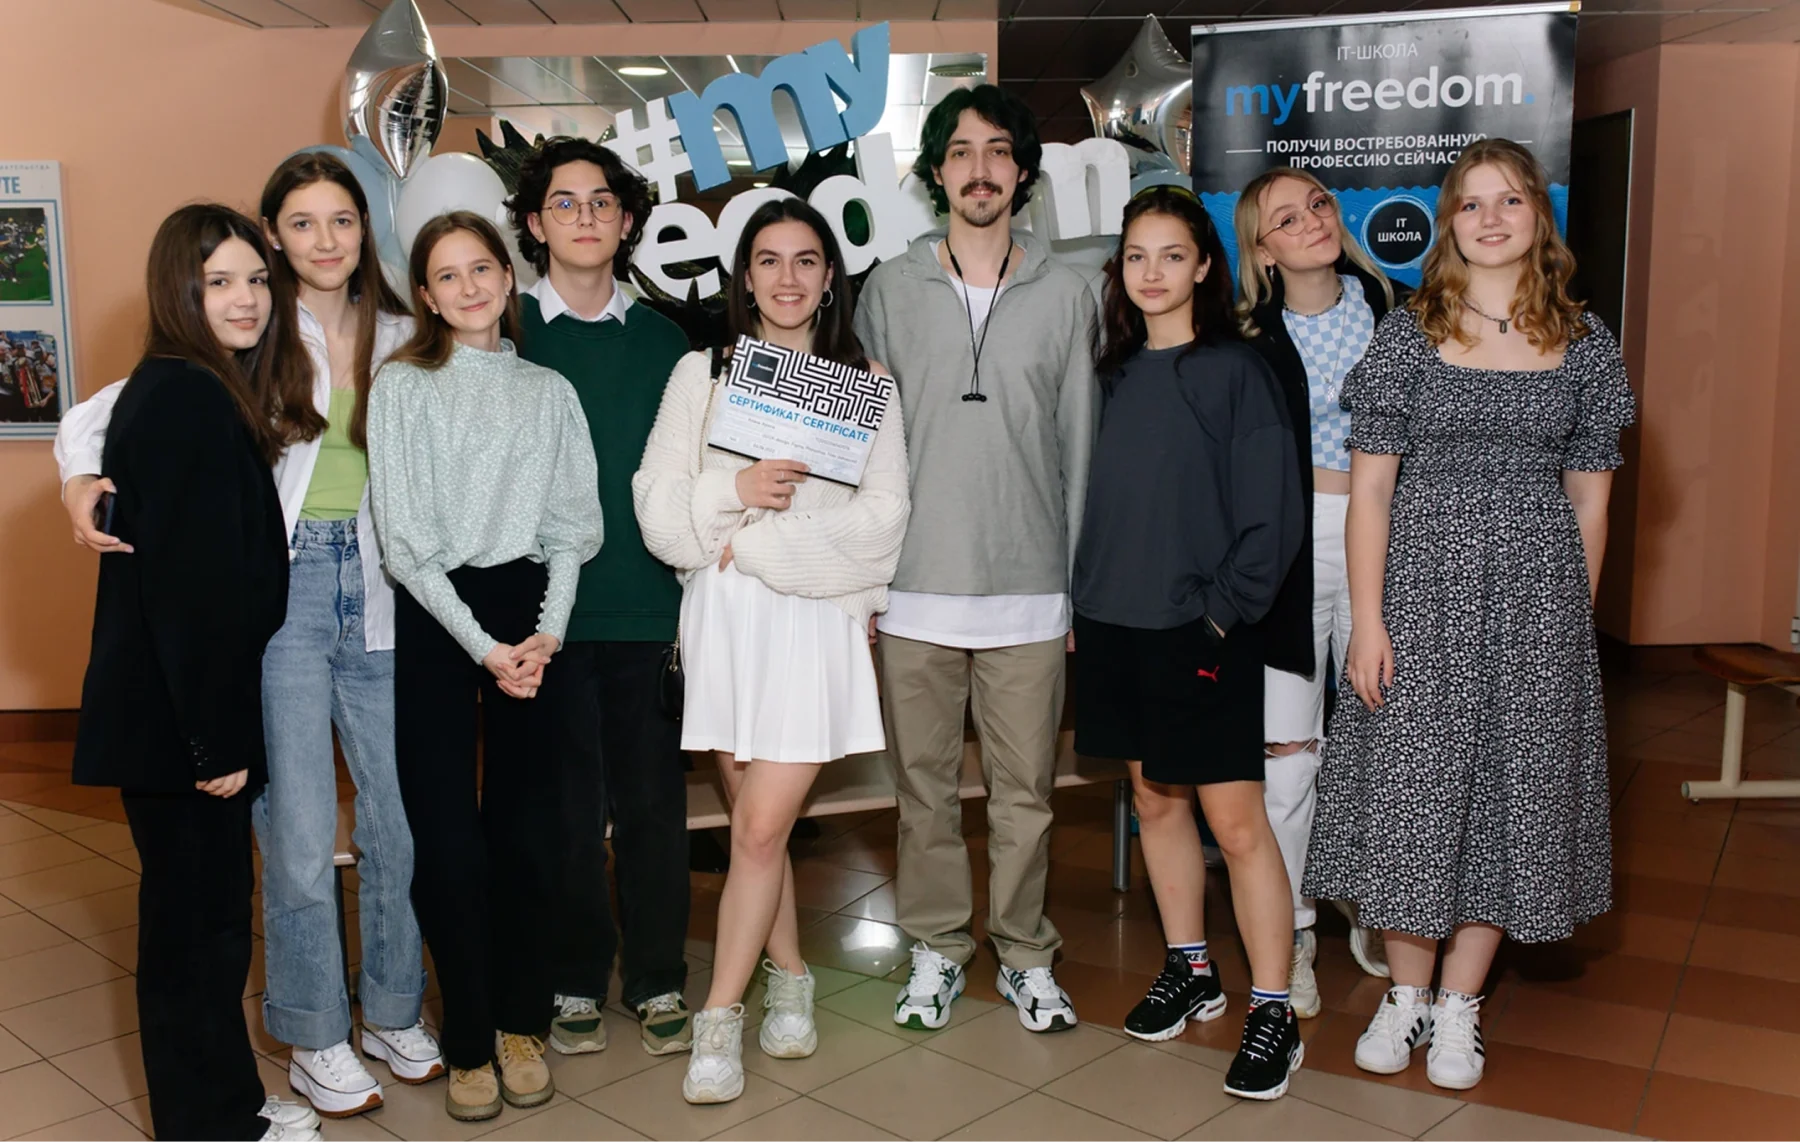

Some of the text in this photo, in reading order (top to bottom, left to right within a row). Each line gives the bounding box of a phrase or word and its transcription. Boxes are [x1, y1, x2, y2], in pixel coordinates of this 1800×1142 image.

[1336, 42, 1419, 62] IT-ШКОЛА
[600, 20, 891, 204] #my
[1266, 138, 1331, 154] ПОЛУЧИ
[1289, 152, 1391, 169] ПРОФЕССИЮ
[1395, 217, 1408, 229] IT
[1377, 230, 1423, 243] ШКОЛА
[728, 393, 801, 423] СЕРТИФИКАТ
[802, 415, 870, 443] CERTIFICATE
